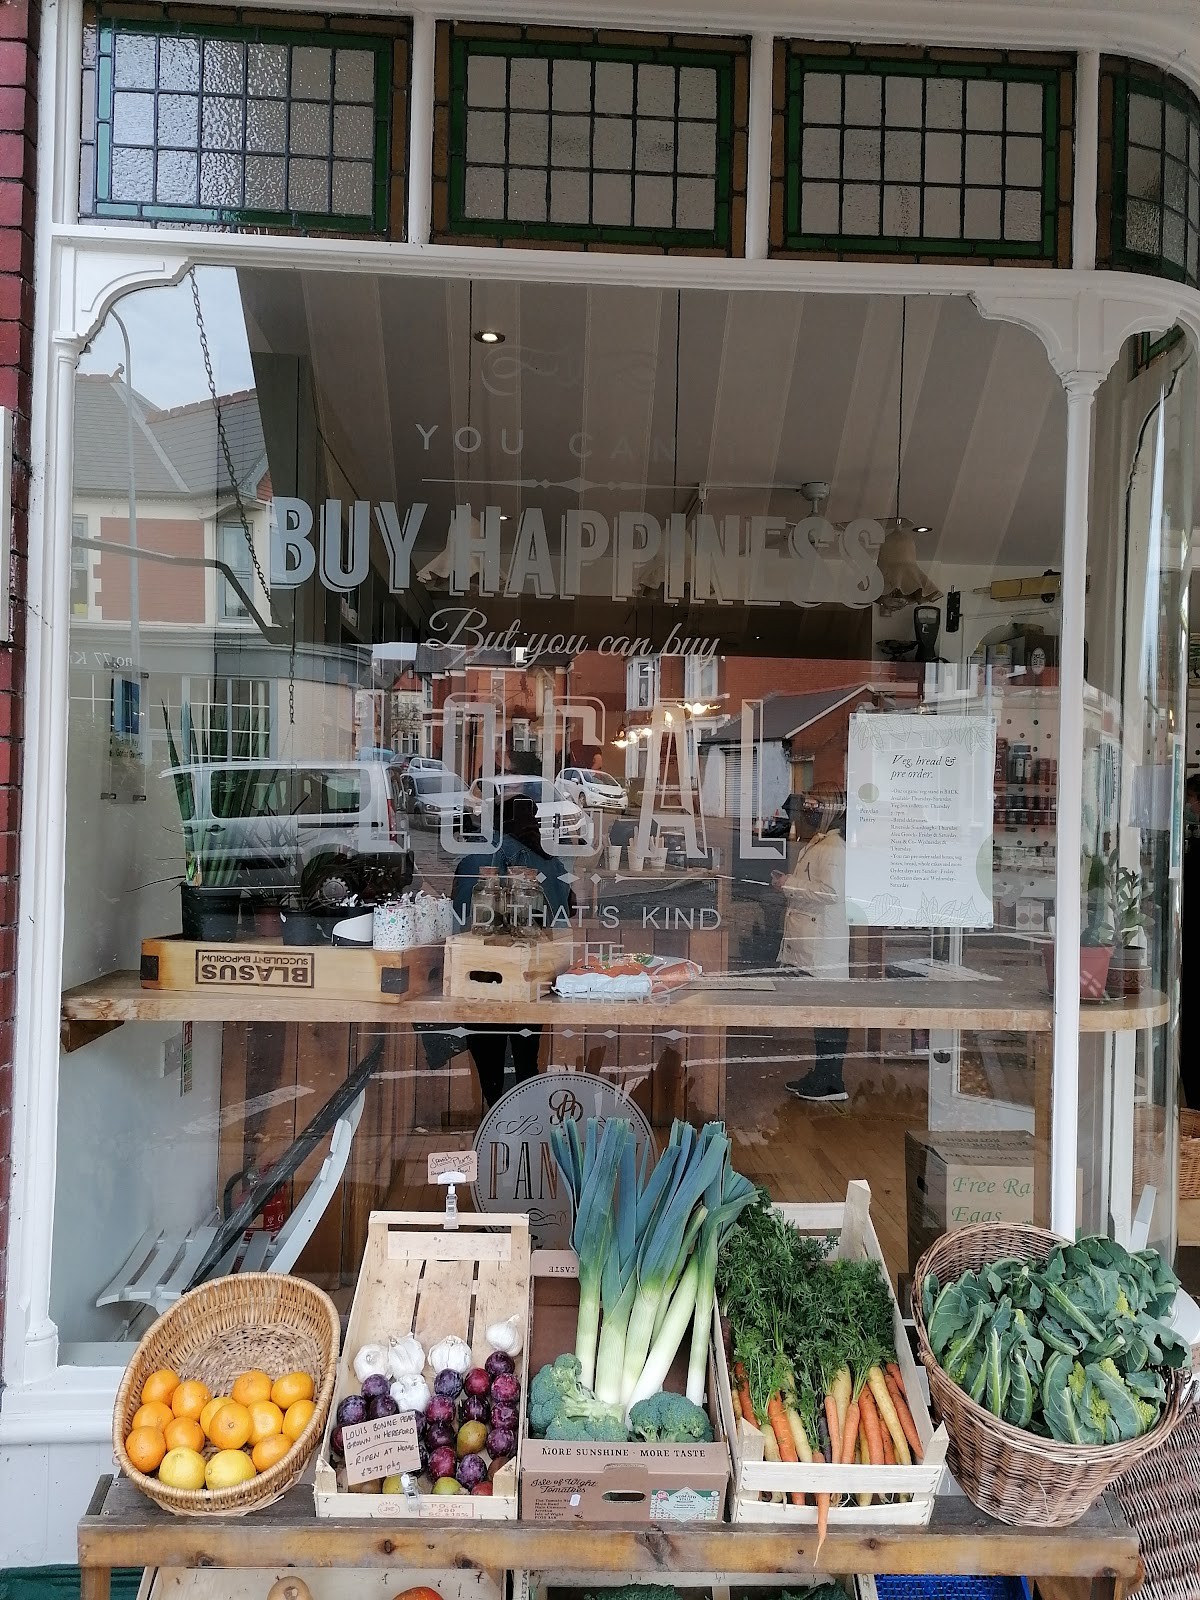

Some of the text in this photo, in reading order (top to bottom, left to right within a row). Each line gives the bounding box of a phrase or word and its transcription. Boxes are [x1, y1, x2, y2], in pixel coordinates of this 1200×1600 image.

[414, 424, 525, 456] YOU
[269, 495, 886, 610] BUY HAPPINESS
[425, 606, 721, 669] But you can buy
[915, 755, 943, 767] bread
[944, 755, 957, 768] &
[357, 691, 788, 860] LOCAL
[889, 768, 933, 781] pre order.
[446, 902, 723, 931] ND THAT'S KIND
[201, 954, 309, 966] SUCCULENT EMPORIUM
[201, 963, 309, 984] BLASUS
[952, 1176, 996, 1194] Free
[345, 1427, 369, 1442] LOUIS
[346, 1427, 416, 1450] GROWN IN HEREFORD
[355, 1451, 380, 1465] RIPEN
[383, 1446, 394, 1456] AT
[541, 1447, 707, 1459] MORE SUNSHINE MORE TASTE
[530, 1478, 599, 1489] Isle of Wight
[539, 1485, 586, 1494] Tomatoes
